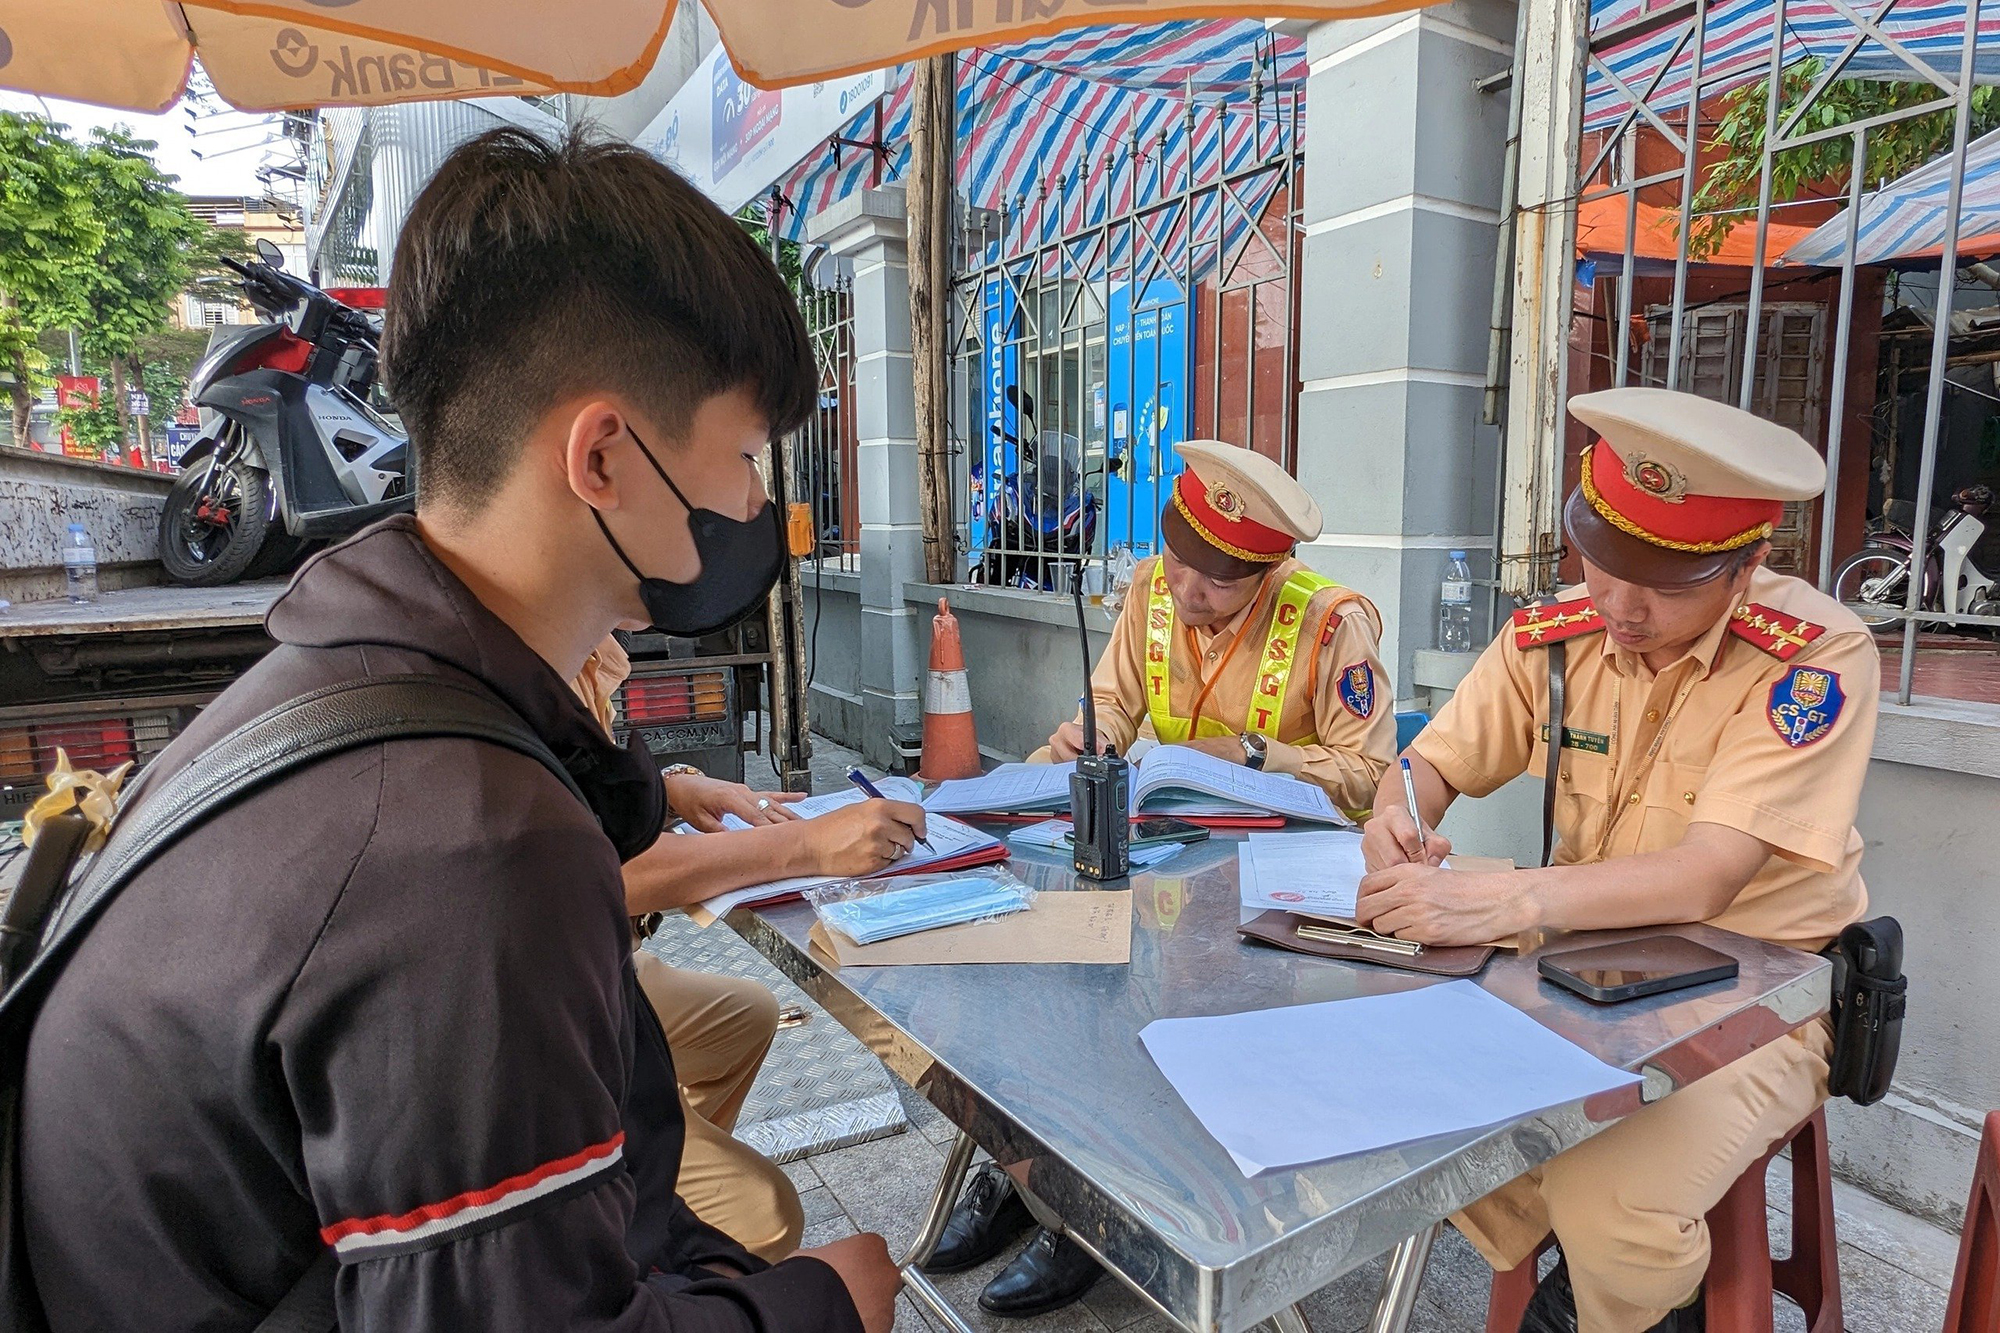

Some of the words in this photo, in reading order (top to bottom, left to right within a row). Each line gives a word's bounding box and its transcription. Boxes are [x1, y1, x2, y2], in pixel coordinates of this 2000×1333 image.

[1113, 332, 1130, 346] CHUYỂ
[989, 322, 1003, 500] inaphone
[1256, 603, 1298, 730] CSGT
[1777, 703, 1801, 717] CS
[1808, 709, 1828, 724] GT
[615, 726, 720, 745] IEOA.COM.VN
